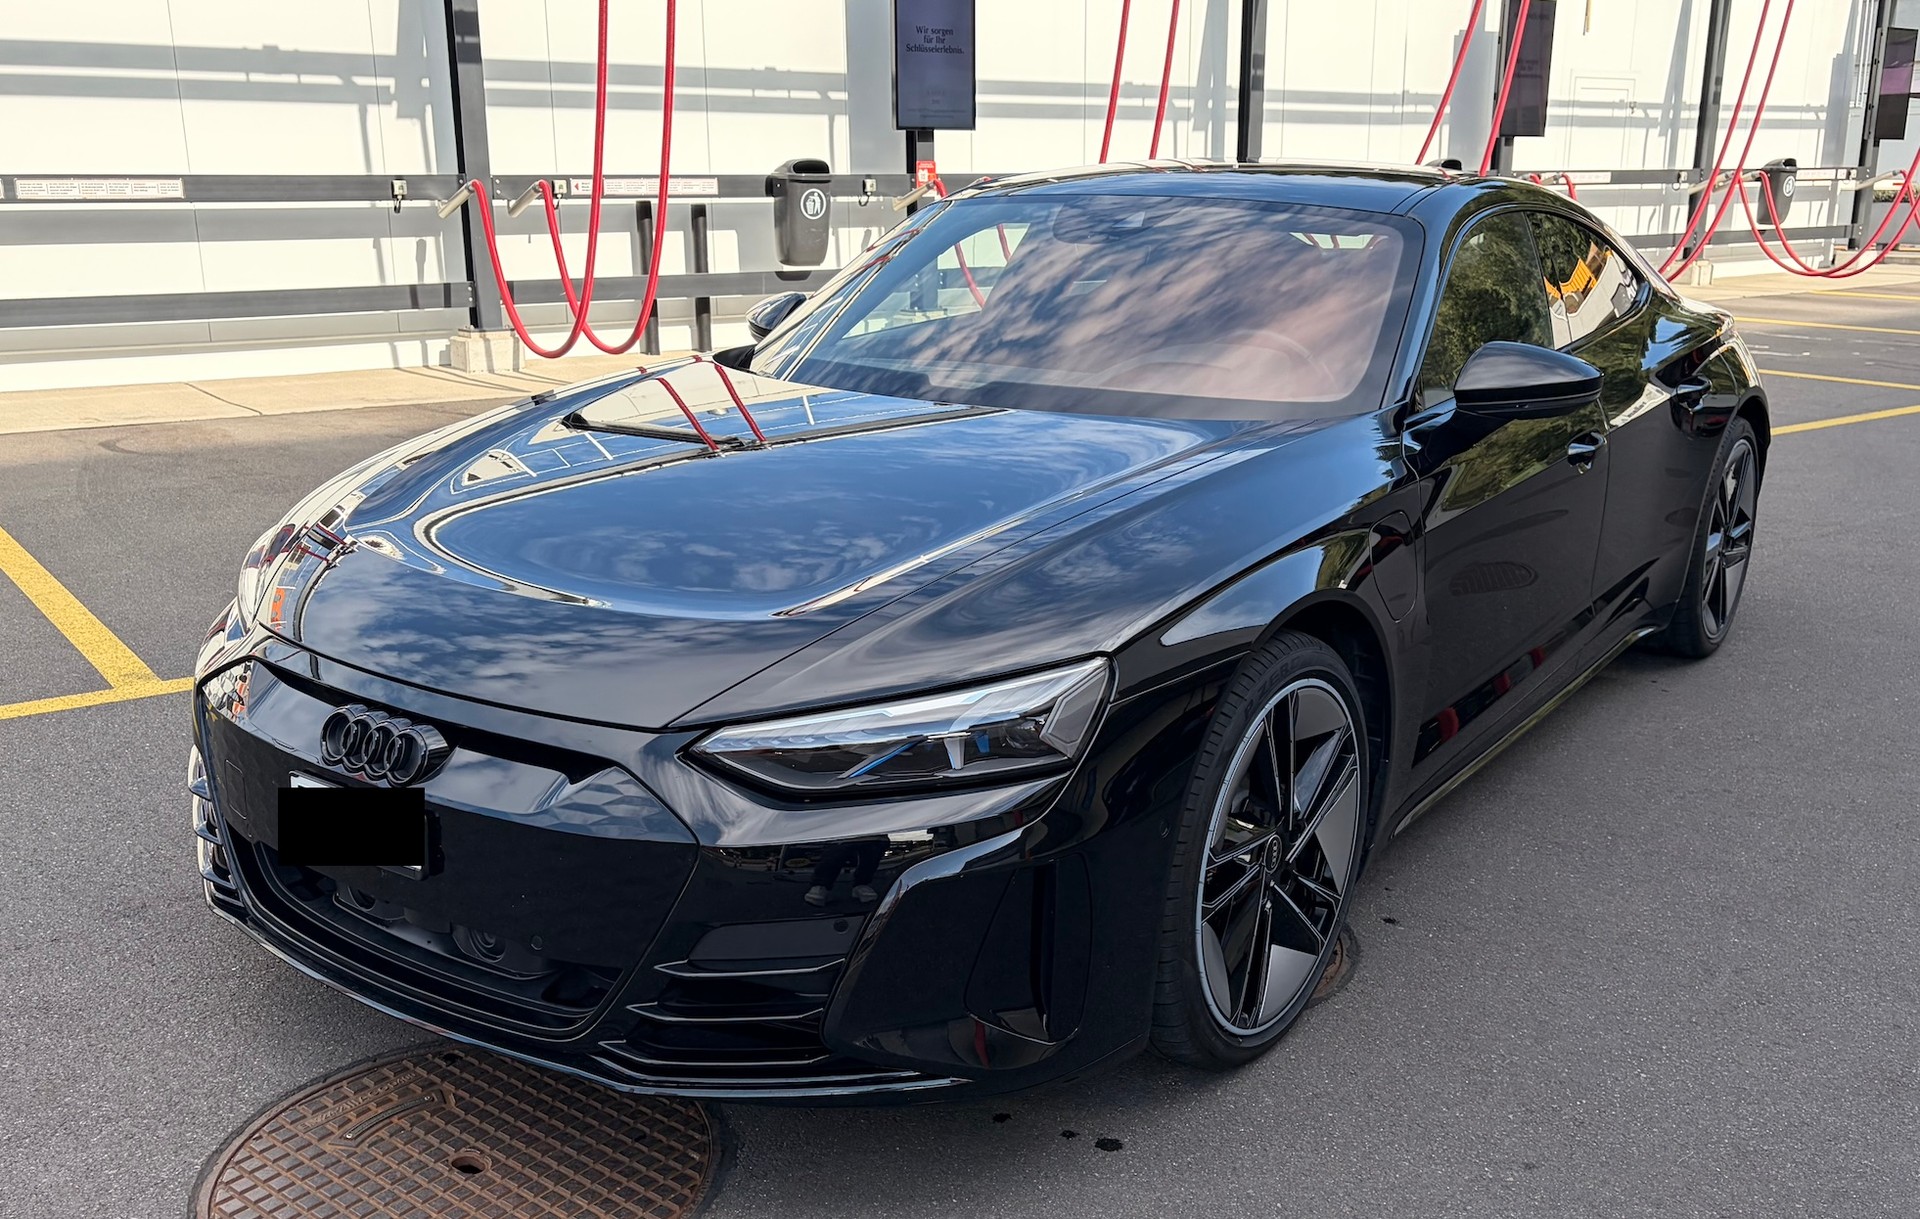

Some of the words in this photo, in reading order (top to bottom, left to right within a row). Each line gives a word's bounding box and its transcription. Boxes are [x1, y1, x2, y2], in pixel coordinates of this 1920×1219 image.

[916, 25, 929, 34] Wir
[931, 27, 954, 37] sorgen
[923, 35, 934, 44] für
[935, 36, 946, 44] Ihr
